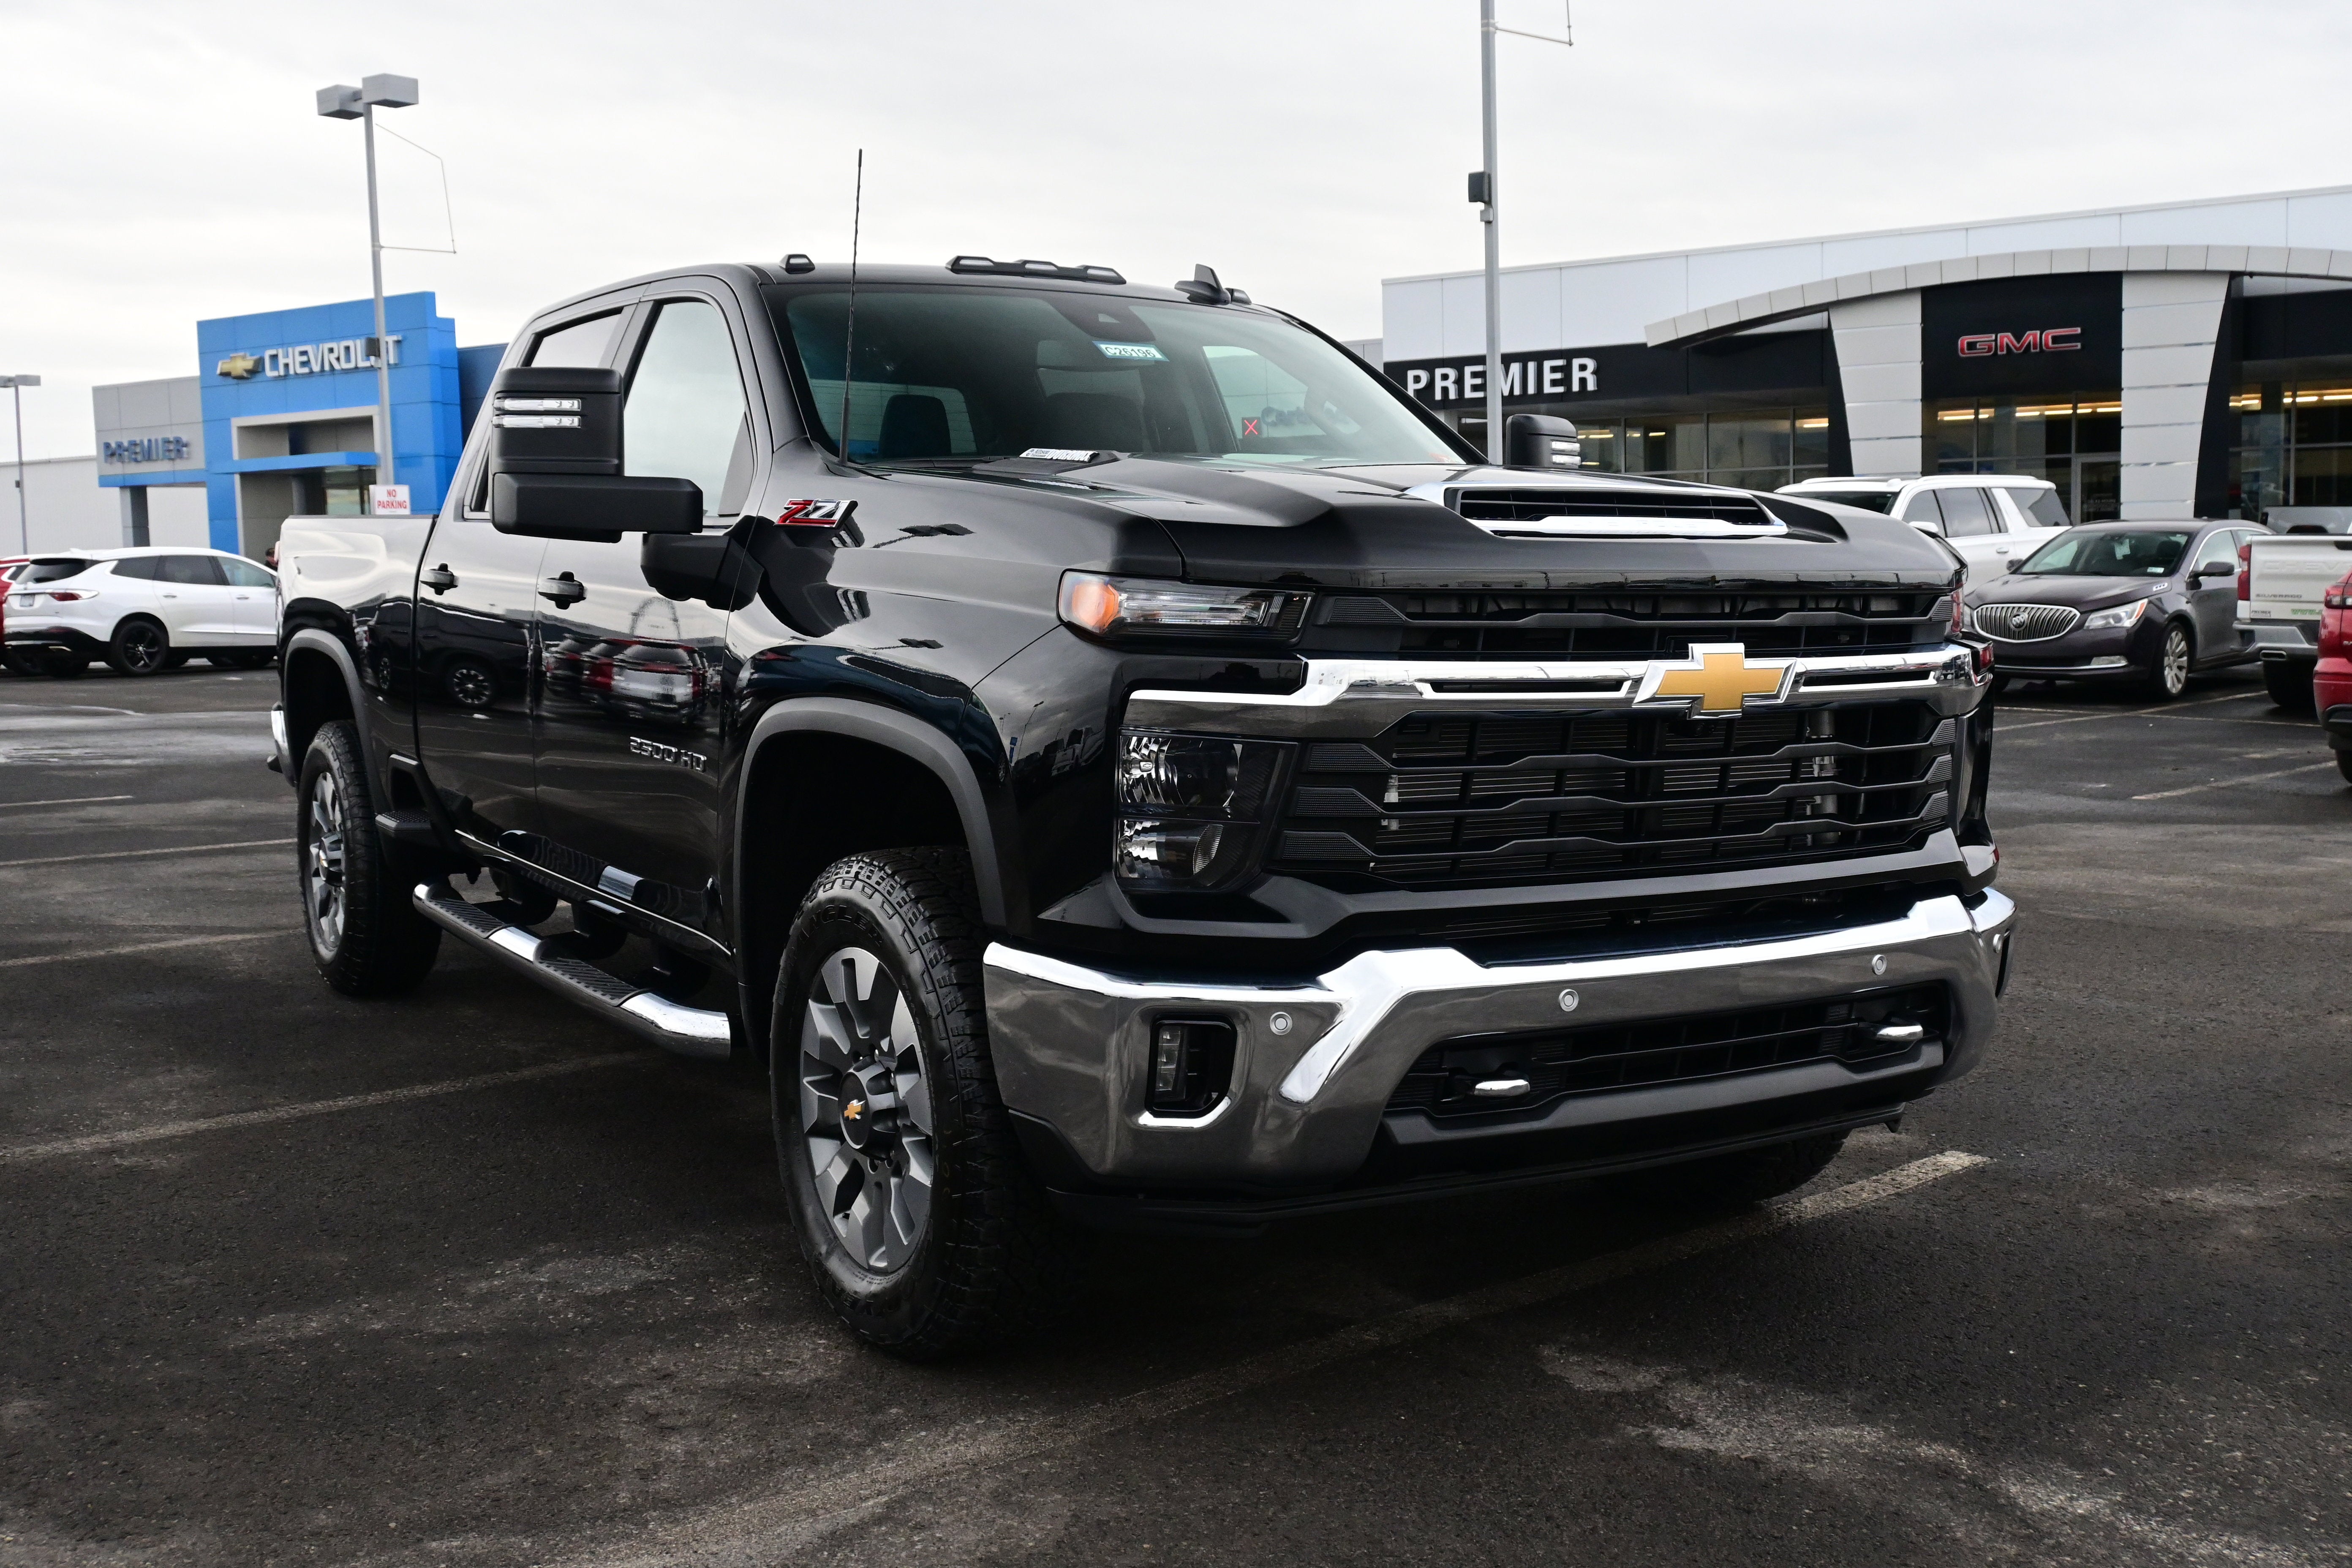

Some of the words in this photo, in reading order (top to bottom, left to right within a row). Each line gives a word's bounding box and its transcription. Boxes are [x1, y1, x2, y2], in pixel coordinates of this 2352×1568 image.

[264, 335, 402, 377] CHEVROLT
[1105, 346, 1155, 358] C26196
[1959, 327, 2081, 357] GMC
[1407, 358, 1597, 400] PREMIER
[103, 436, 189, 463] PREMIER
[1047, 449, 1098, 462] DURAMAX
[377, 501, 407, 509] PARKING
[387, 489, 396, 498] NO
[775, 498, 856, 528] Z71
[630, 736, 678, 764] 2500
[680, 750, 707, 773] HD
